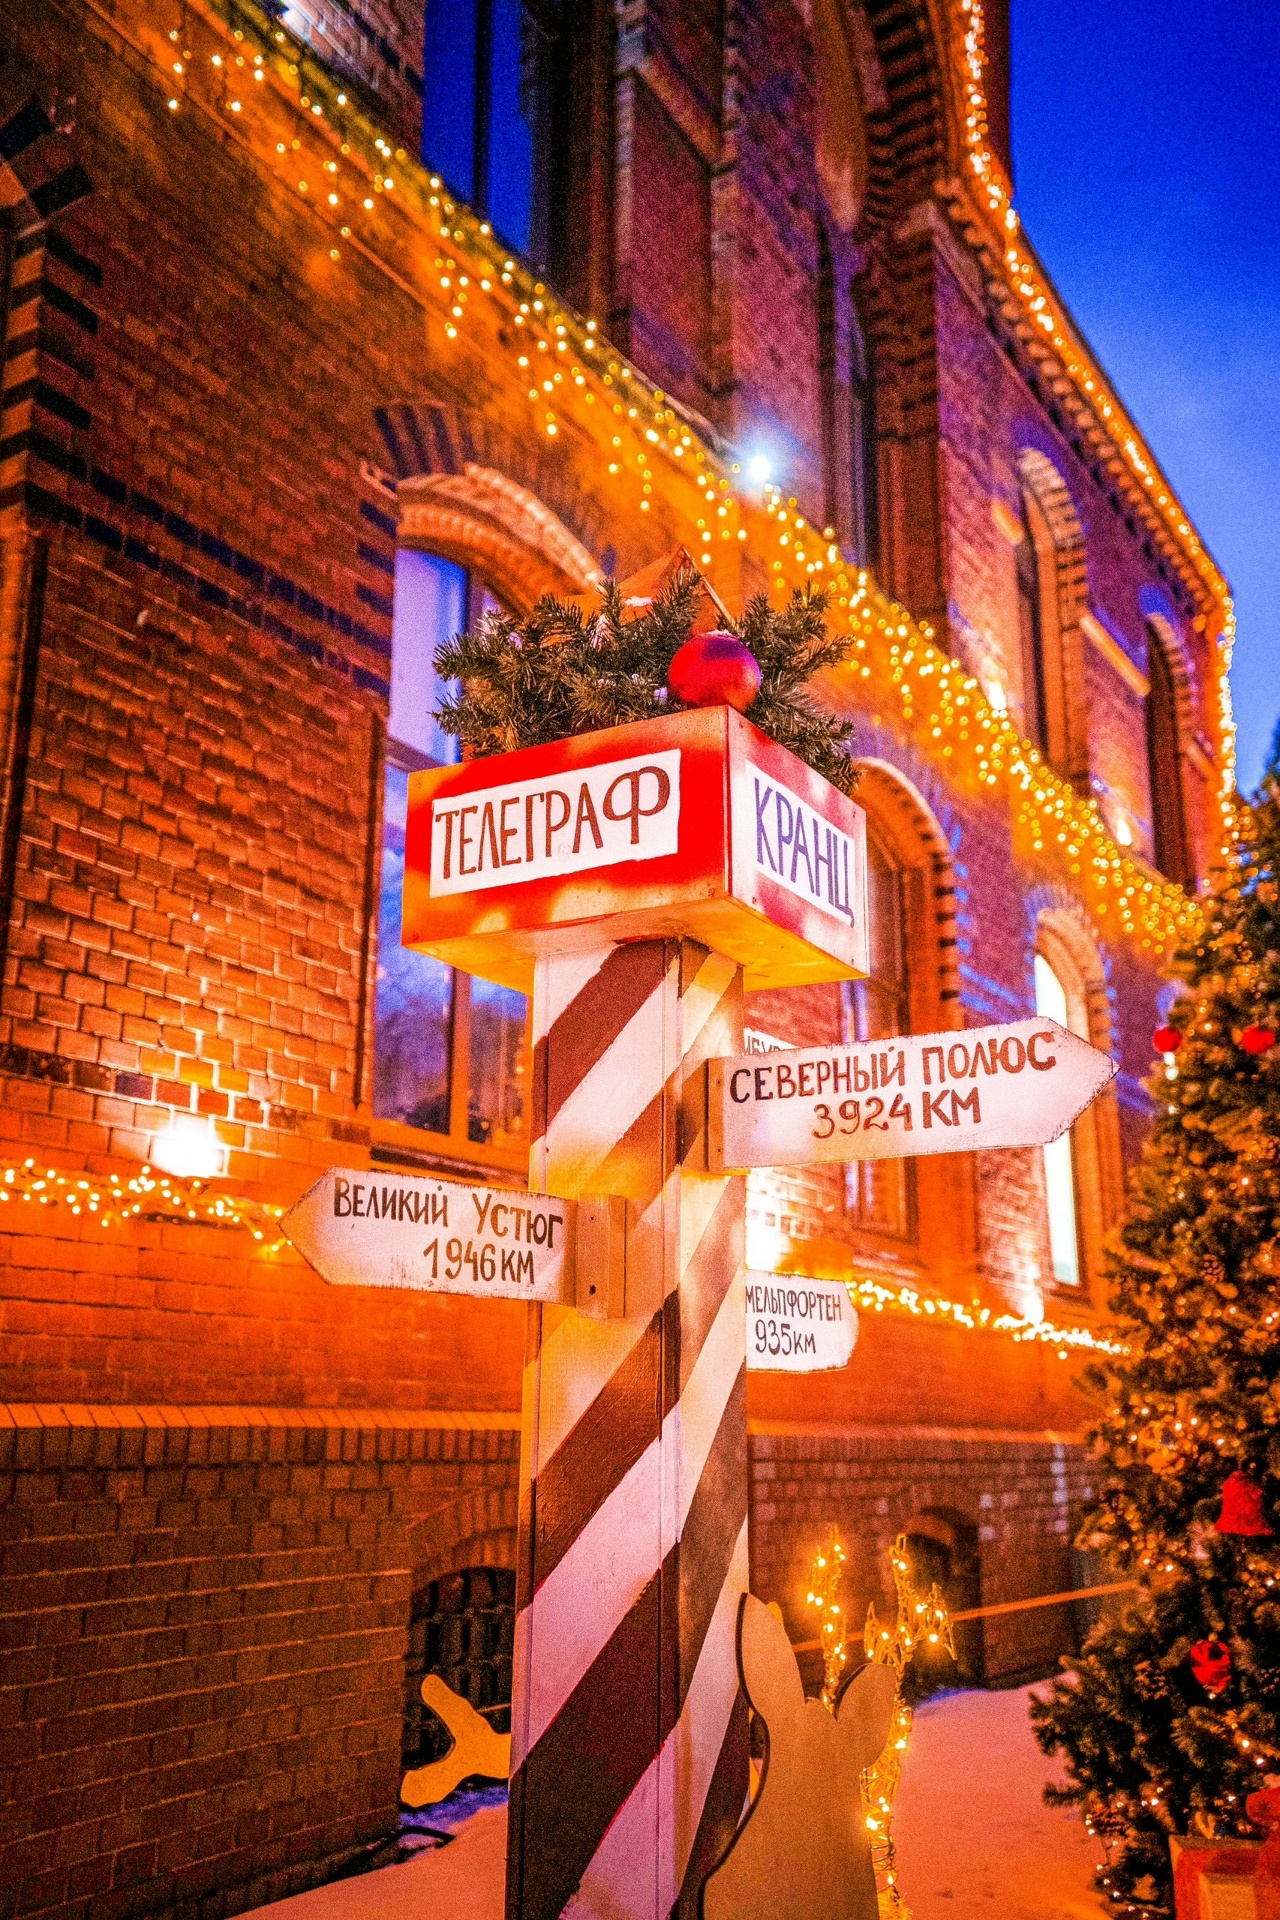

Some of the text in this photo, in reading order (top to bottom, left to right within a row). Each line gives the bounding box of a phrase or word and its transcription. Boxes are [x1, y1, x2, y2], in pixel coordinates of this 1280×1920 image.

[435, 766, 671, 879] ТЕЛЕГРАФ
[753, 776, 856, 928] КРАНЦ
[729, 1031, 1056, 1103] СЕВЕРНЫЙ ПОЛЮС
[334, 1176, 563, 1248] ВЕЛИКИЙ УСТЮГ
